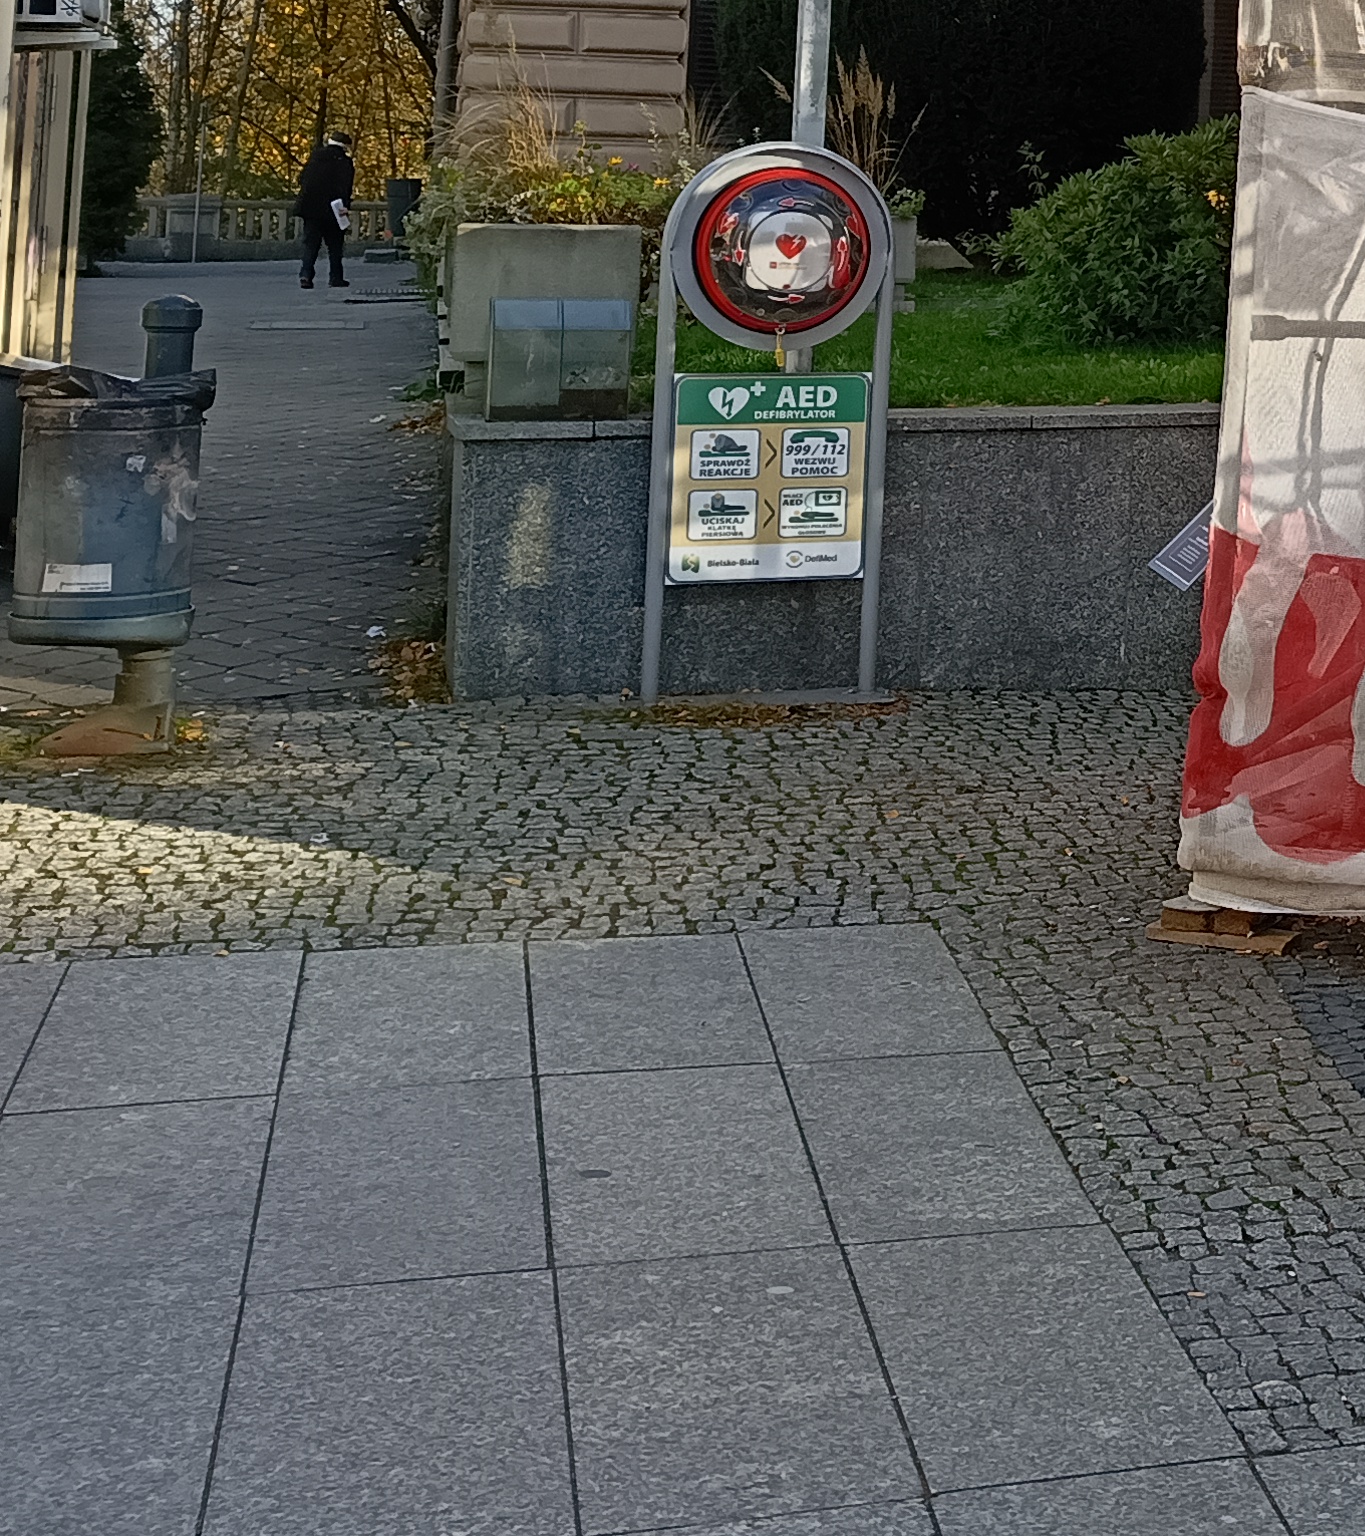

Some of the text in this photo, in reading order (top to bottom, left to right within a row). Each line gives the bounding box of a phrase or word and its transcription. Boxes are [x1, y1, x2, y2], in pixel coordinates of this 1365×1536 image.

[775, 385, 838, 408] AED
[754, 410, 836, 420] DEFIBRYLATOR
[794, 457, 836, 465] WEZWIJ
[791, 466, 838, 475] POMOC
[782, 498, 803, 506] AED
[701, 517, 745, 525] UCISKAJ
